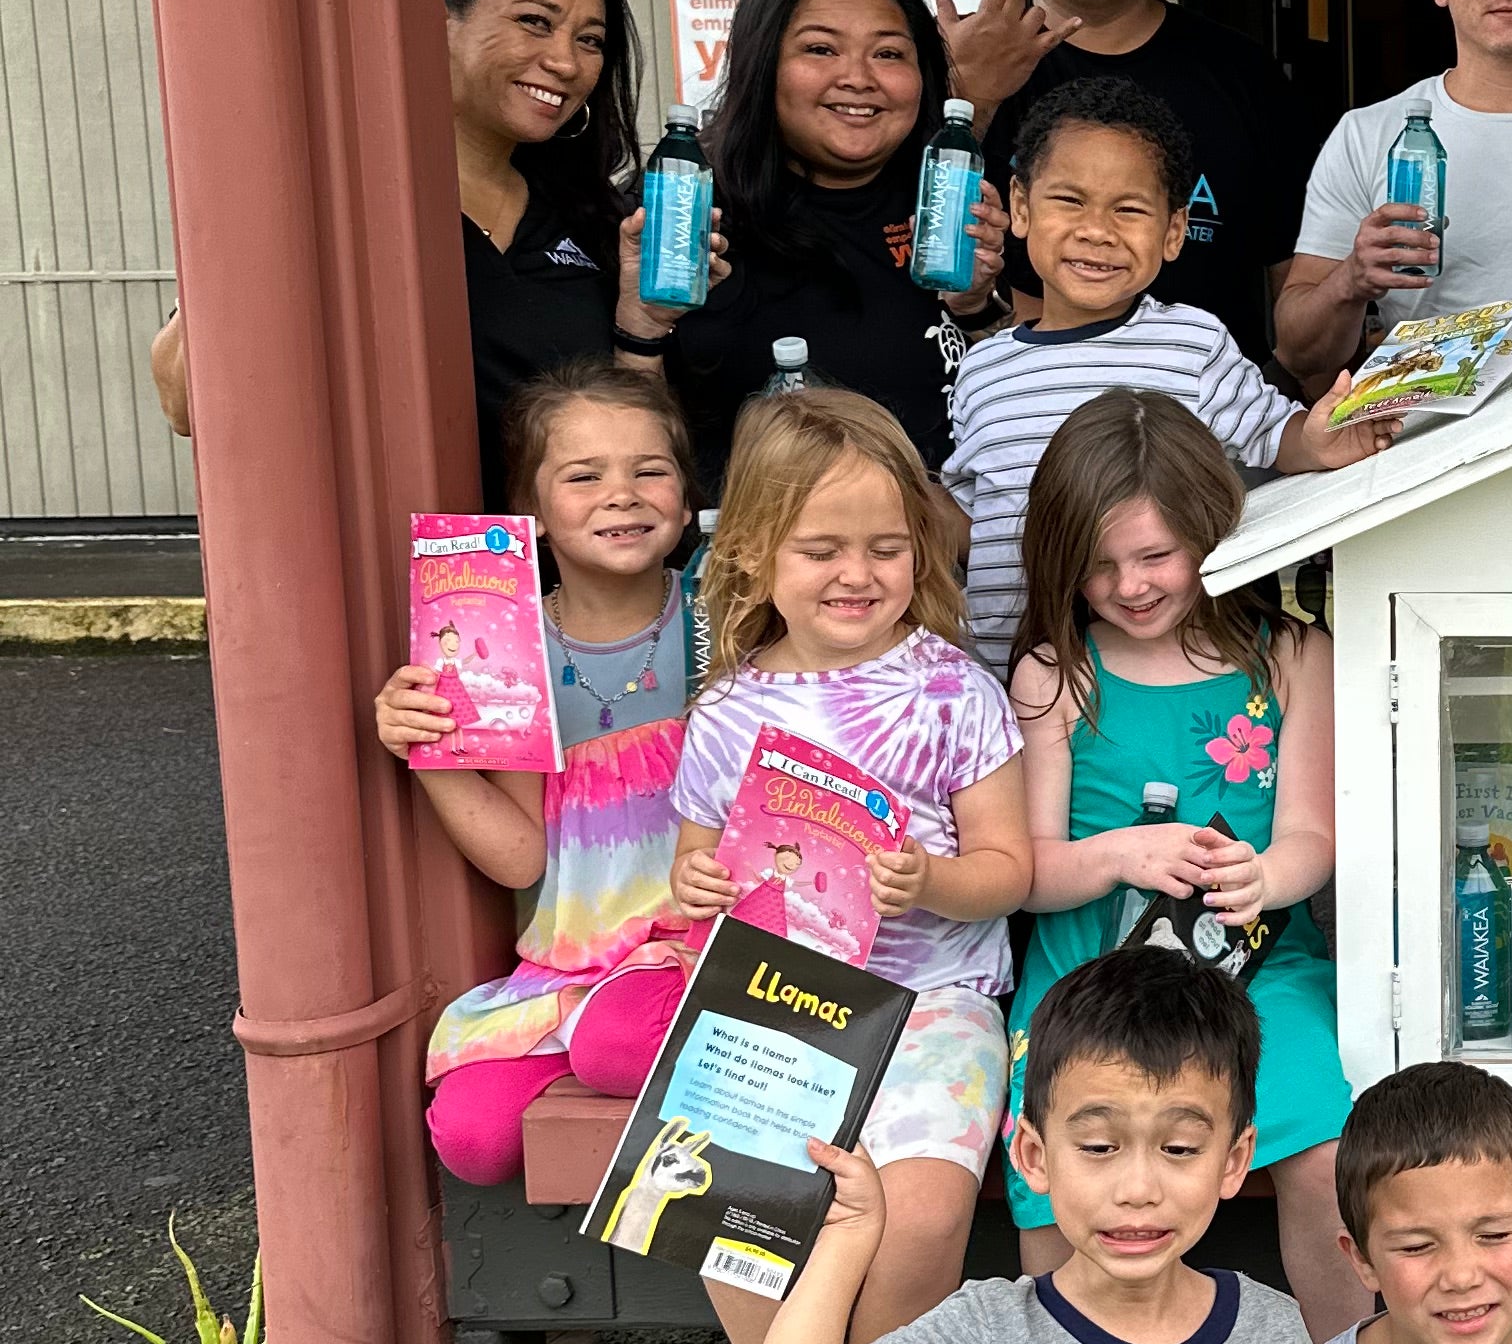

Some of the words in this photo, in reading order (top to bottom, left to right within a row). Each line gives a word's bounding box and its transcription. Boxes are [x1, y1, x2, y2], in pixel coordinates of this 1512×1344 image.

[674, 173, 695, 249] WAIAKEA
[928, 159, 951, 230] WAIAKEA
[1423, 164, 1438, 232] WAIAKEA
[424, 541, 429, 553] I
[430, 541, 449, 554] Can
[451, 537, 480, 551] Read!
[493, 532, 500, 547] 1
[421, 558, 518, 599] Pinkalicious
[694, 595, 712, 679] WAIAKEA
[781, 759, 788, 770] I
[789, 763, 820, 784] Can
[822, 775, 862, 800] Read!
[1456, 783, 1500, 799] First
[874, 798, 881, 810] 1
[1474, 906, 1489, 990] WAIAKEA
[713, 1026, 739, 1043] What
[740, 1038, 749, 1048] is
[752, 1044, 759, 1052] a
[762, 1046, 798, 1065] llama?
[697, 1058, 721, 1074] Let's
[724, 1068, 745, 1083] find
[748, 1078, 769, 1092] out!
[705, 1043, 732, 1059] What
[734, 1054, 748, 1065] do
[750, 1060, 784, 1079] llamas
[787, 1074, 809, 1089] look
[811, 1082, 836, 1098] like?
[680, 1101, 712, 1120] reading
[690, 1078, 712, 1091] Learn
[714, 1086, 739, 1100] about
[790, 1114, 816, 1129] simple
[753, 1113, 770, 1126] that
[770, 1120, 792, 1134] helps
